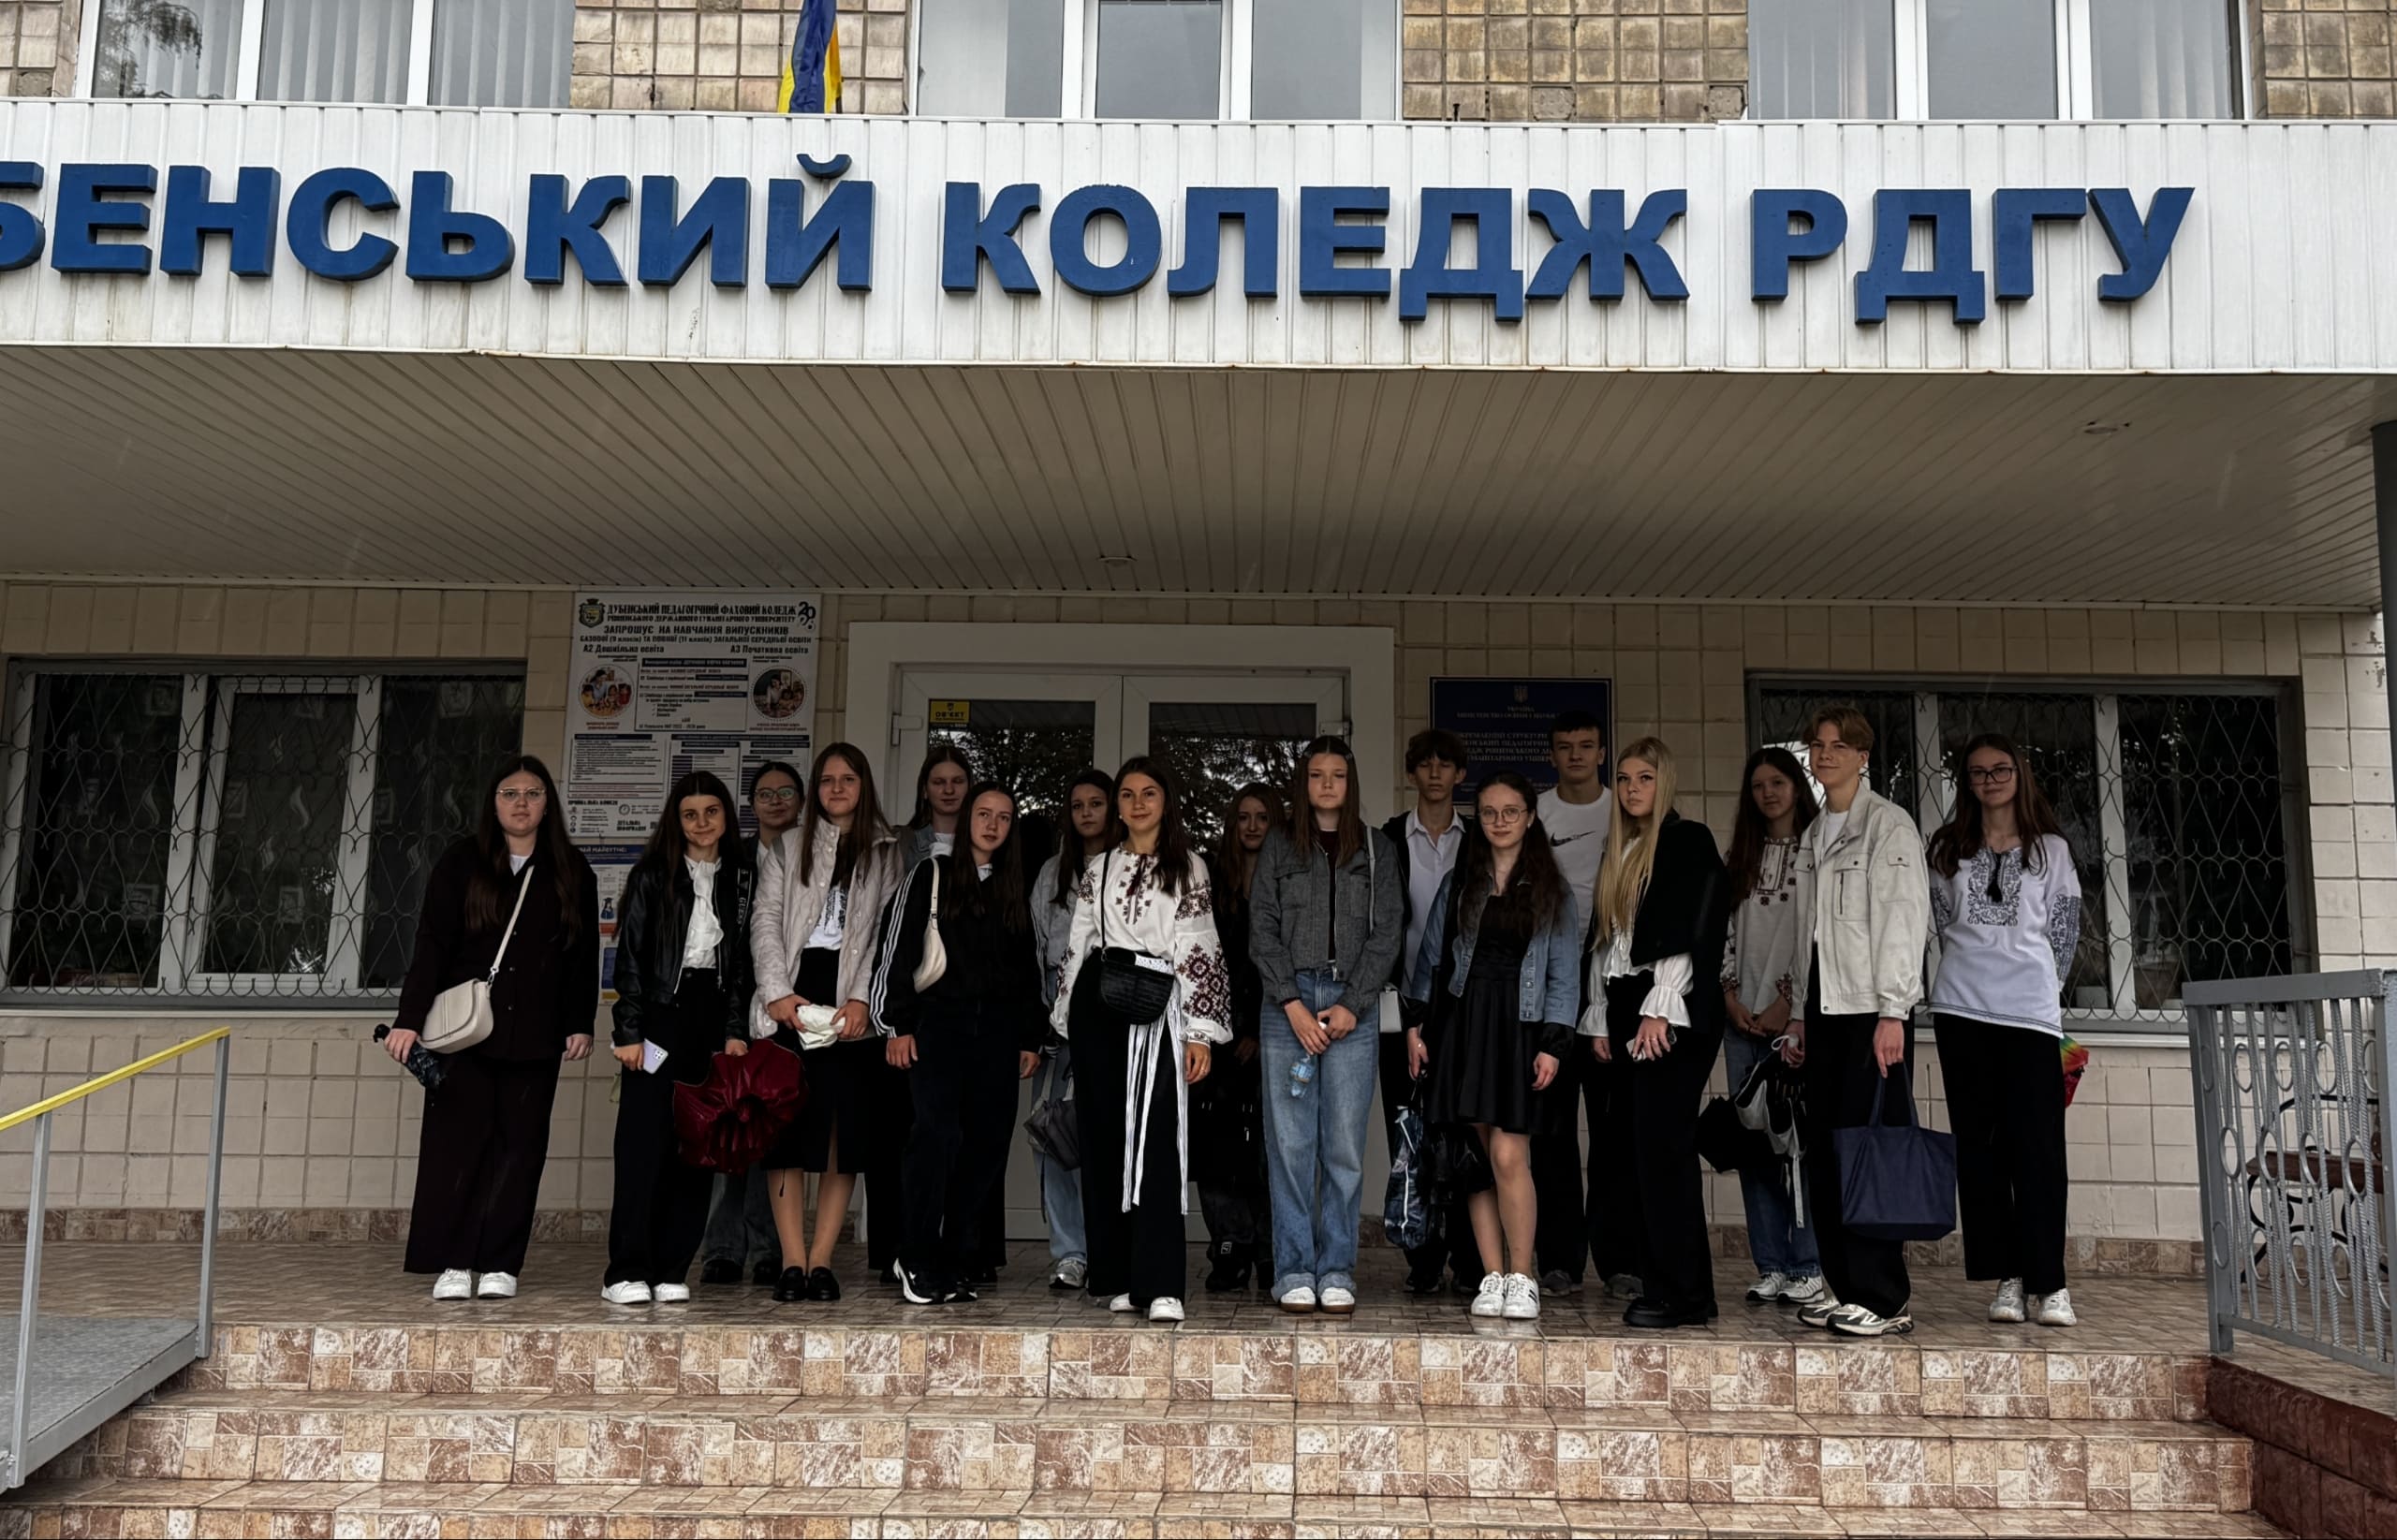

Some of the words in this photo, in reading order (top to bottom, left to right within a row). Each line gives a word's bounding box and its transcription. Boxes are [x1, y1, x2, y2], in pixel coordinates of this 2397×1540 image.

[942, 182, 1690, 322] КОЛЕДЖ
[1751, 187, 2195, 325] РДГУ
[604, 625, 654, 635] ЗАПРОШУЄ
[658, 625, 670, 634] НА
[673, 625, 722, 634] НАВЧАННЯ
[725, 626, 788, 635] ВИПУСКНИКІВ
[596, 644, 638, 653] Дошкільна
[640, 644, 664, 653] освіта
[743, 645, 783, 653] Початкова
[785, 645, 809, 653] освіта
